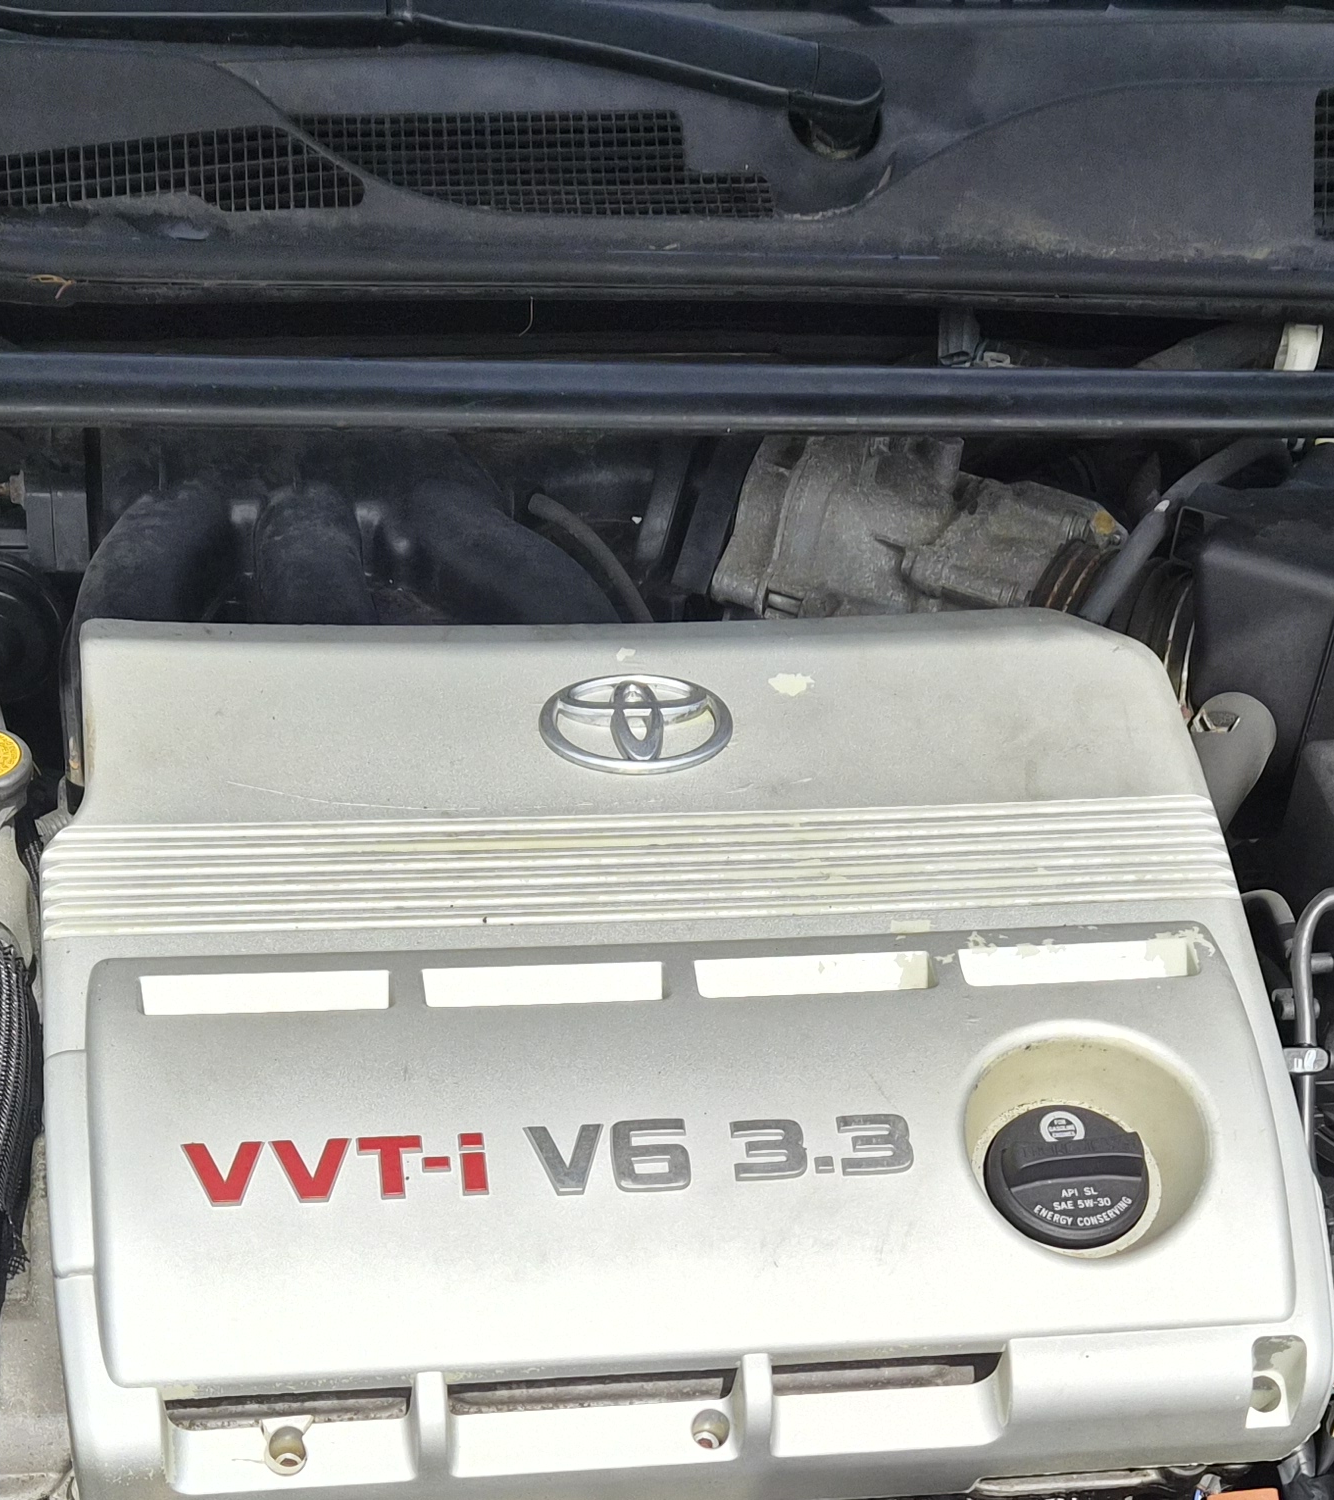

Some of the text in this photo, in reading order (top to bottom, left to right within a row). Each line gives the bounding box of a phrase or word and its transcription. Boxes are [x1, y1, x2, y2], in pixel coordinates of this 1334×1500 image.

[180, 1113, 916, 1208] VVT-i V6 3.3
[1060, 1186, 1098, 1198] API SL
[1033, 1195, 1132, 1227] ENERGY CONSERVING
[1052, 1197, 1111, 1211] SAE 5W-30
